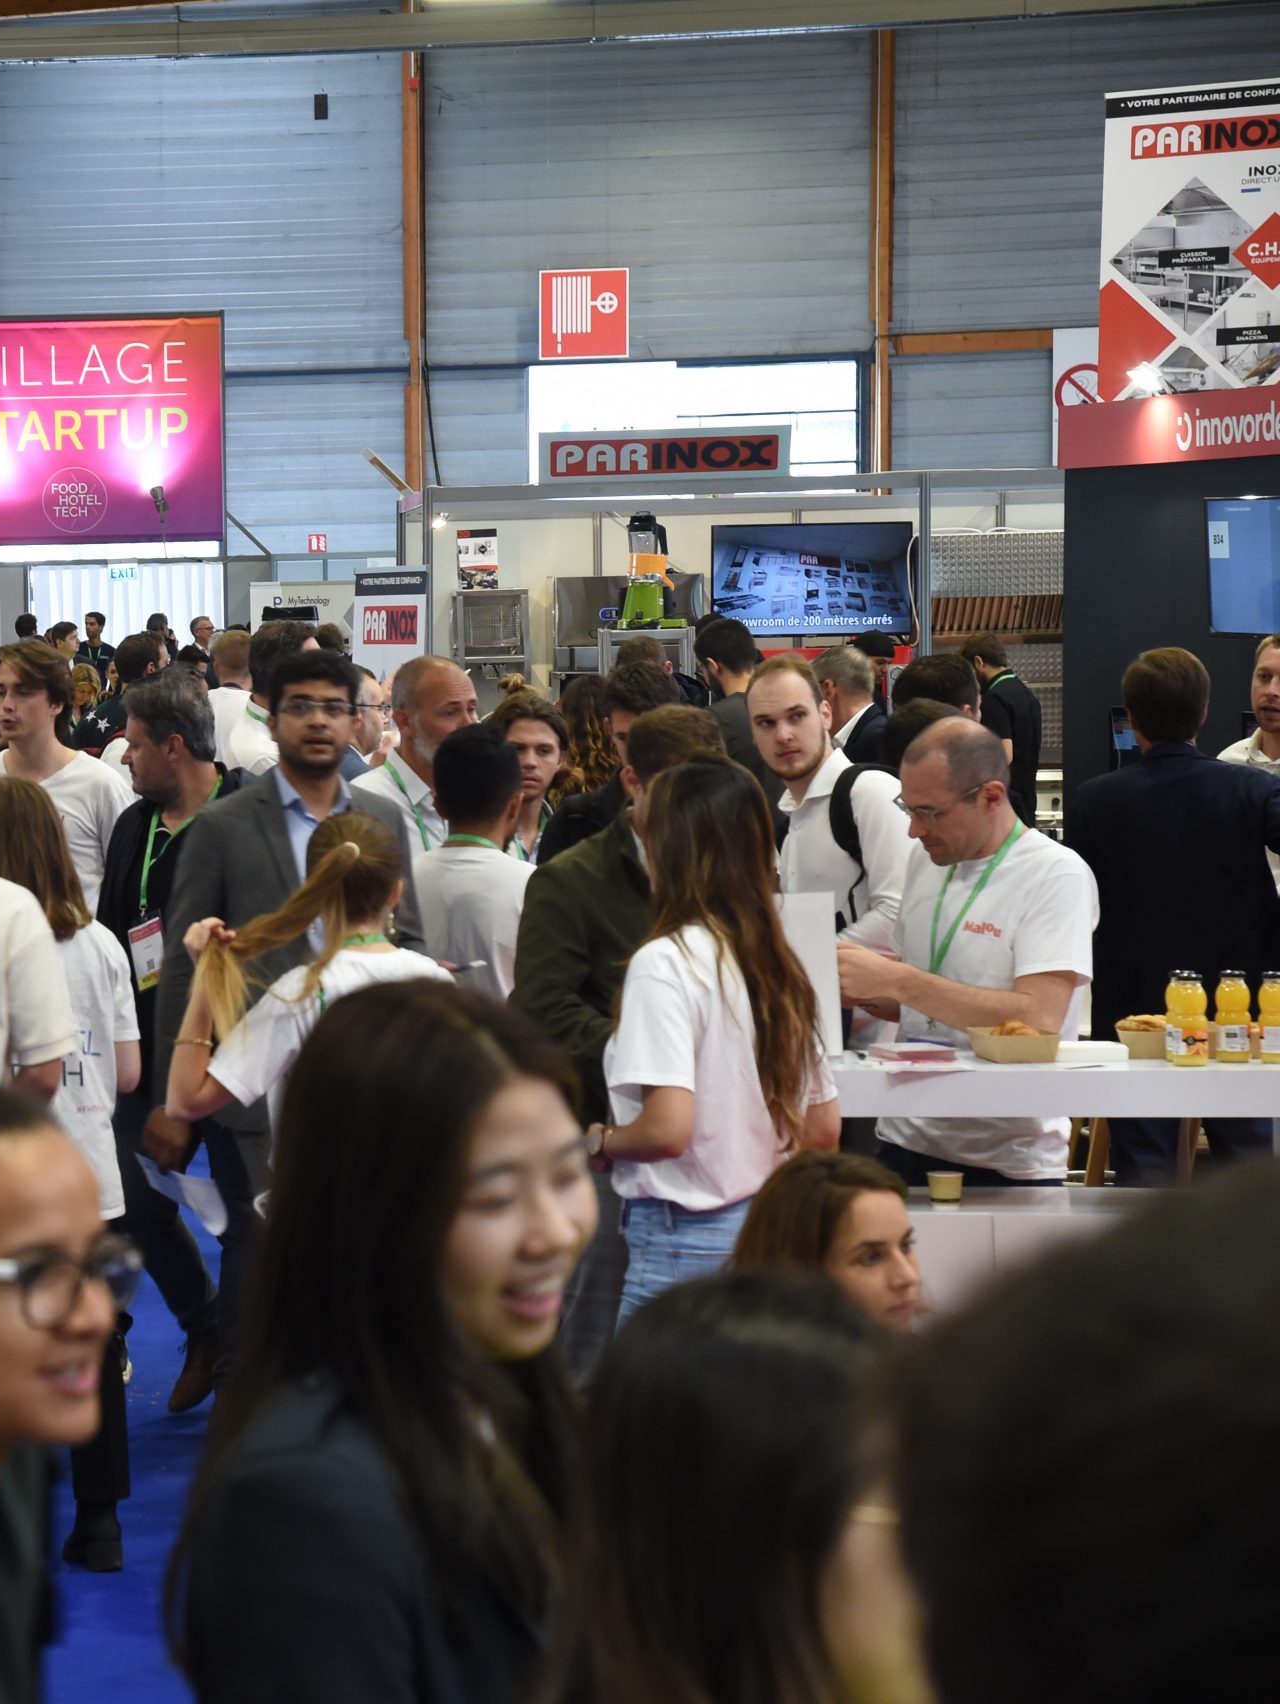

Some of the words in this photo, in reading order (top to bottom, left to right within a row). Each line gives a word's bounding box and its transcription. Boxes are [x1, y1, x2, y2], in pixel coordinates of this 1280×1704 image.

[1127, 99, 1161, 108] VOTRE
[1162, 92, 1227, 105] PARTENAIRE
[1228, 91, 1242, 99] DE
[1243, 88, 1280, 98] CONFIA
[1248, 164, 1280, 177] INO
[556, 439, 773, 473] PARINOX
[51, 482, 88, 494] FOOD
[59, 494, 102, 506] HOTEL
[53, 506, 88, 518] TECH
[110, 567, 136, 579] EXIT
[287, 595, 331, 607] MyTechnology
[364, 609, 417, 641] PARINOX
[787, 616, 801, 627] de
[803, 616, 821, 626] 200
[824, 614, 859, 626] mètres
[862, 613, 893, 625] carrés
[963, 920, 1002, 938] Malou
